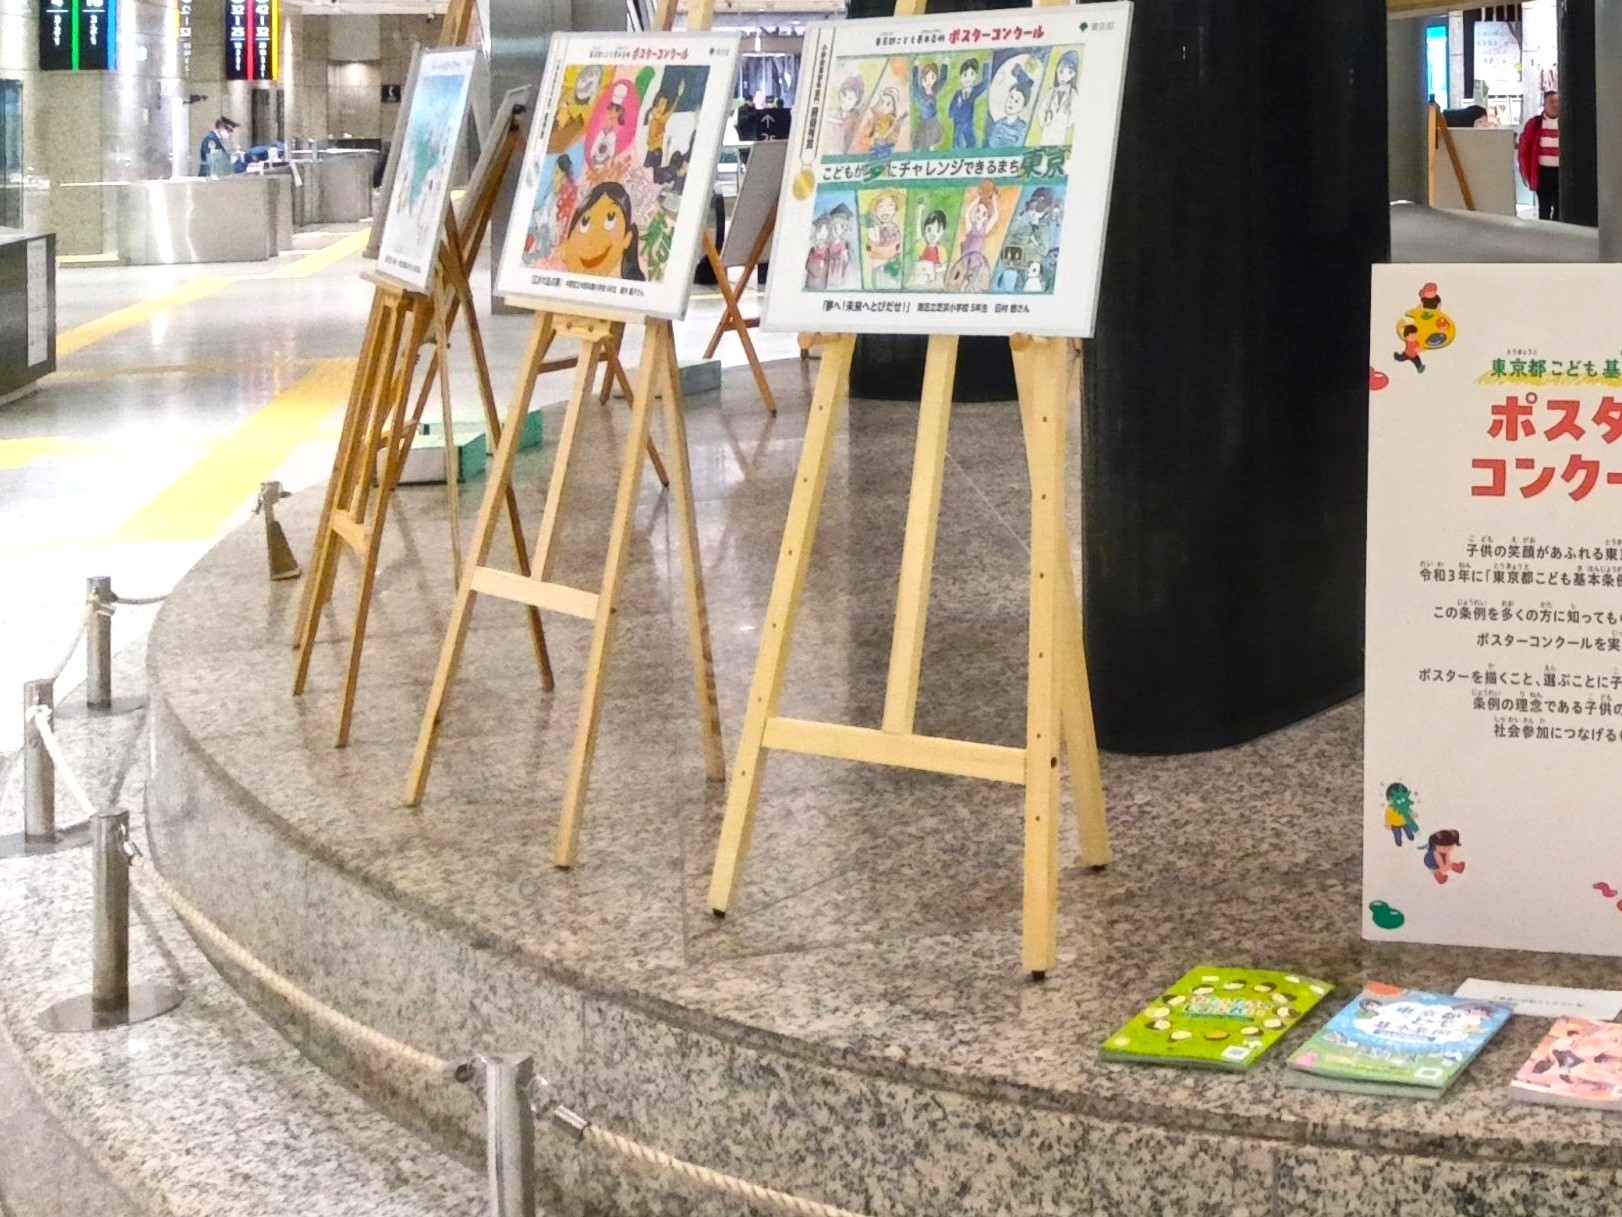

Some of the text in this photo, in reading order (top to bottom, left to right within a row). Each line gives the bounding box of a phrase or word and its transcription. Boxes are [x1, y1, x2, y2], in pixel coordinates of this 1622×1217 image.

[949, 25, 1044, 44] ポスターコンクール
